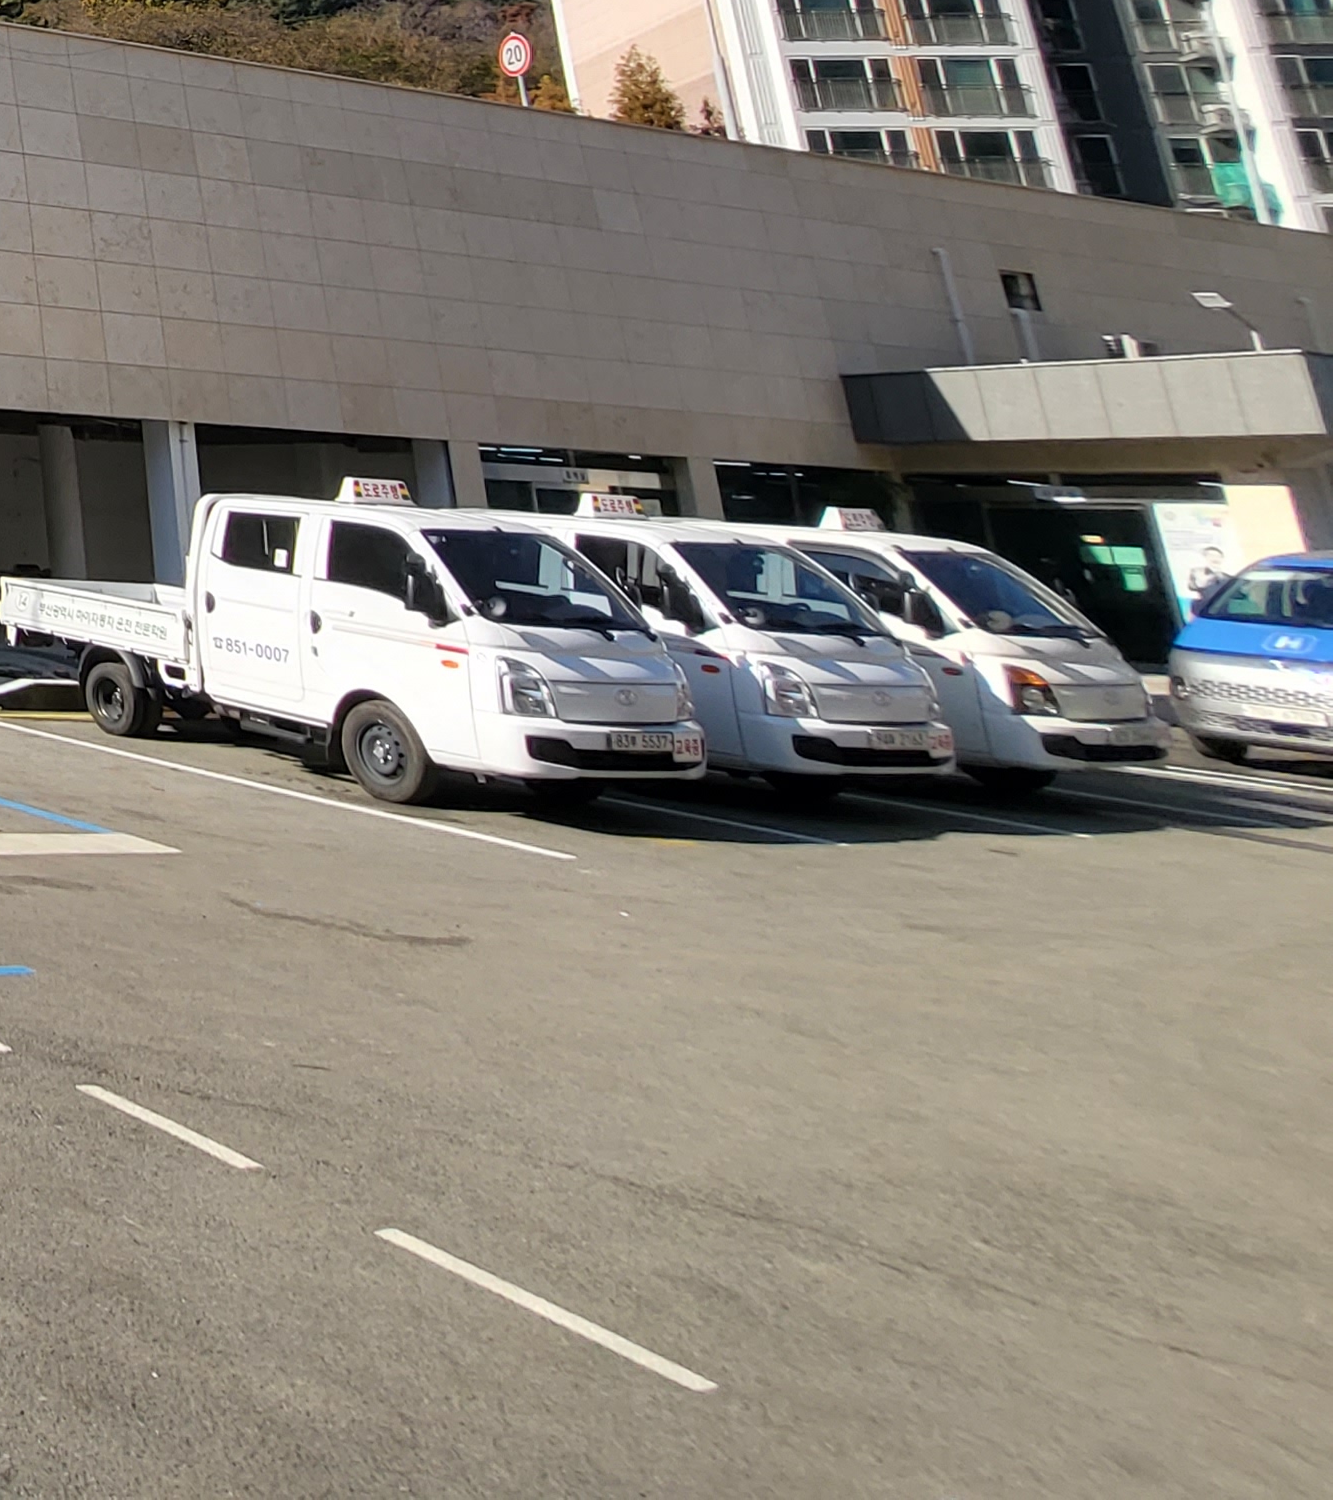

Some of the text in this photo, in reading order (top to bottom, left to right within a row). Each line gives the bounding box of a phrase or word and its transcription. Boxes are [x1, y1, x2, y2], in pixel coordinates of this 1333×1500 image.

[505, 44, 523, 66] 20
[363, 482, 399, 500] 도로주행
[600, 498, 634, 514] 도로주행
[39, 603, 74, 620] 부산광역시
[116, 617, 132, 633] 운전
[134, 622, 167, 641] 전문학원
[225, 638, 289, 663] 851-0007
[641, 734, 669, 749] 5537
